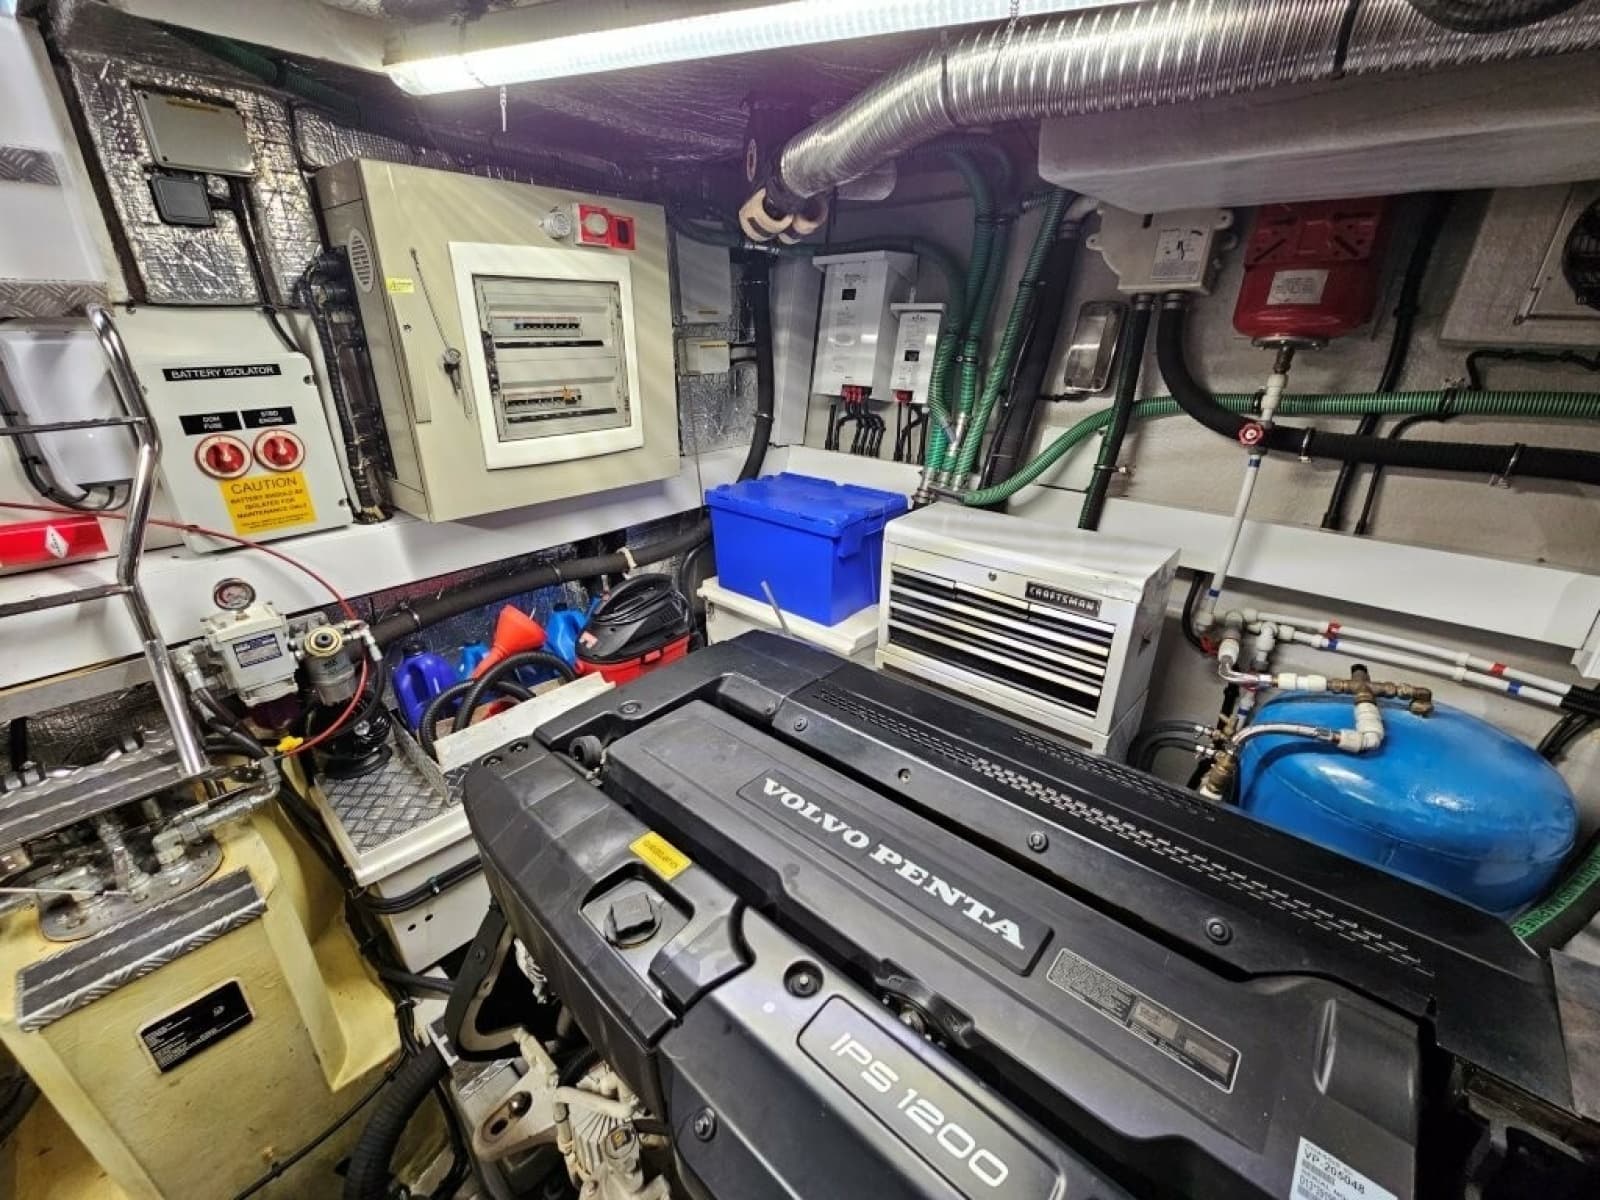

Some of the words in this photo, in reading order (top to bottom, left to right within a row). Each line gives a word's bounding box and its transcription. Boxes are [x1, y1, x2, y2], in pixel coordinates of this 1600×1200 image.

[171, 368, 221, 379] BATTERY
[223, 366, 275, 376] ISOLATOR
[230, 476, 298, 495] CAUTION
[1029, 586, 1095, 611] CRAFTSMAN
[763, 777, 870, 849] VOLVO
[869, 843, 1025, 950] PENTA
[830, 1032, 899, 1093] IPS
[897, 1088, 1009, 1187] 1200
